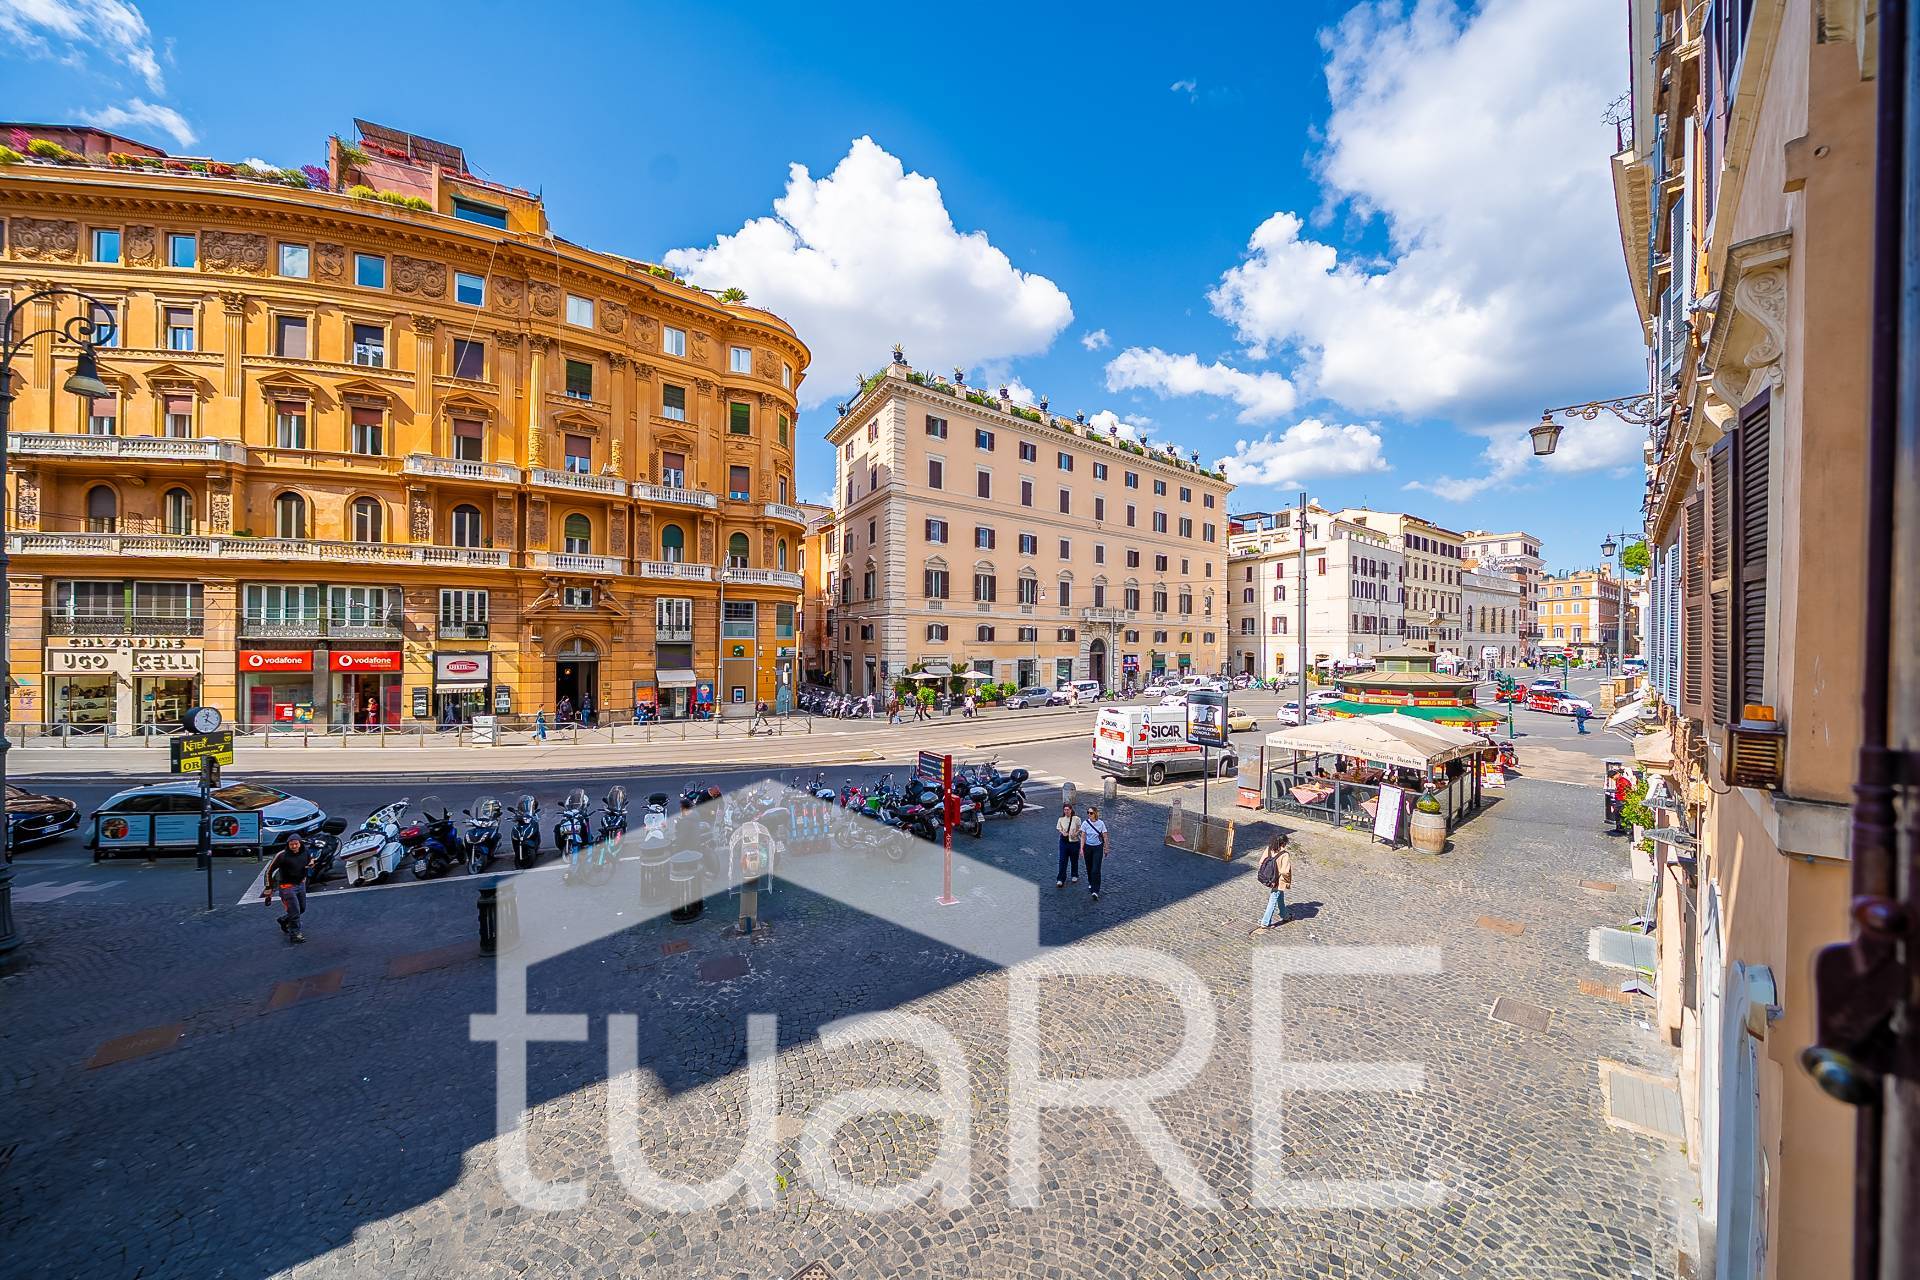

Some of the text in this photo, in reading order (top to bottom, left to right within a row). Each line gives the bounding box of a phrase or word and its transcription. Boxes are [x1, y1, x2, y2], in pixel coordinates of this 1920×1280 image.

[68, 638, 186, 648] CALZATURE
[63, 653, 109, 669] UGO
[264, 656, 303, 665] vodafone
[353, 656, 392, 665] vodafone
[1151, 724, 1182, 739] SICAR
